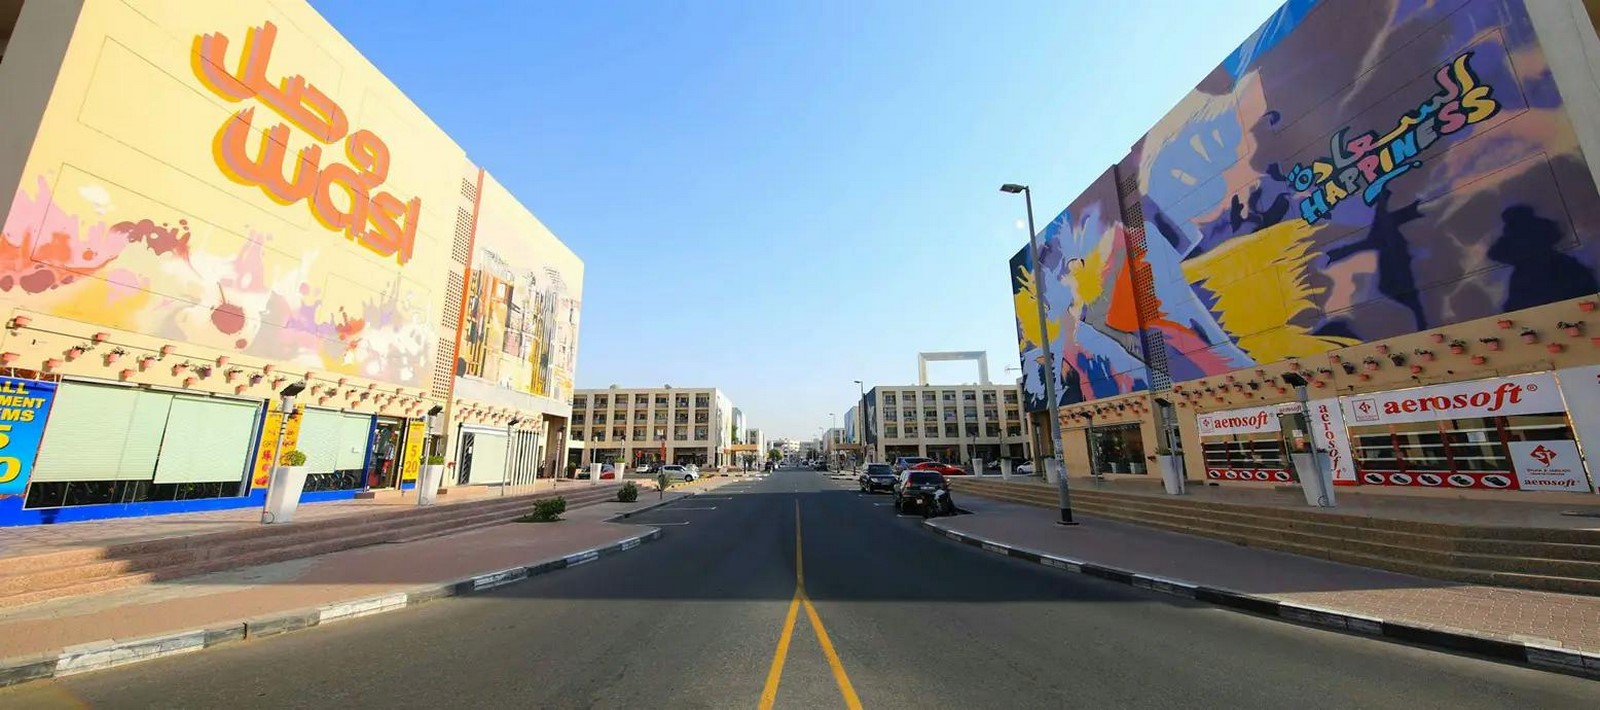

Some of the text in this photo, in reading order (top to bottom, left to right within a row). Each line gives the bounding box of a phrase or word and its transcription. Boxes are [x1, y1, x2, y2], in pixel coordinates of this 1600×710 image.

[1300, 86, 1501, 225] HAPPINESS
[212, 106, 421, 266] wasl
[0, 381, 29, 395] LL
[1384, 382, 1523, 412] aerosoft
[0, 408, 35, 422] MS
[1214, 411, 1269, 429] aerosoft
[1319, 404, 1342, 479] aerosoft
